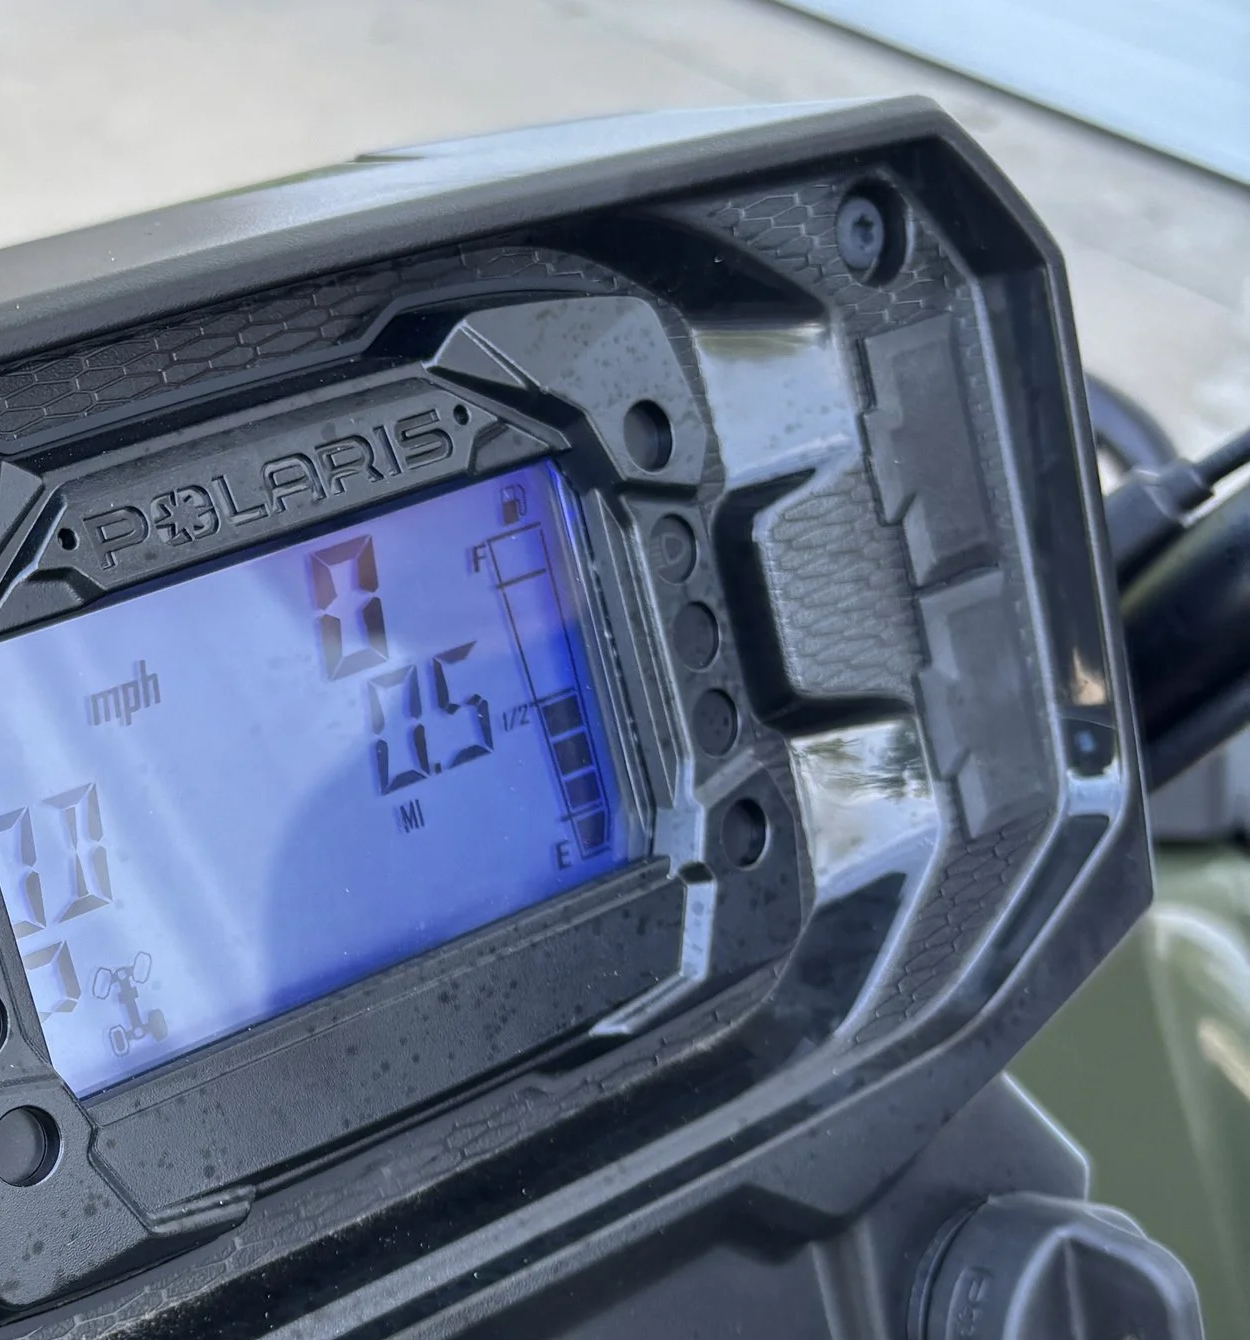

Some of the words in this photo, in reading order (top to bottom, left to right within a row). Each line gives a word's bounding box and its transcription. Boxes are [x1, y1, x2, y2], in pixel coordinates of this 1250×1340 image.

[82, 408, 456, 570] POLARIS
[472, 544, 488, 573] F
[88, 659, 161, 727] mph
[309, 533, 390, 681] 0
[398, 799, 426, 833] MI
[555, 839, 574, 871] E
